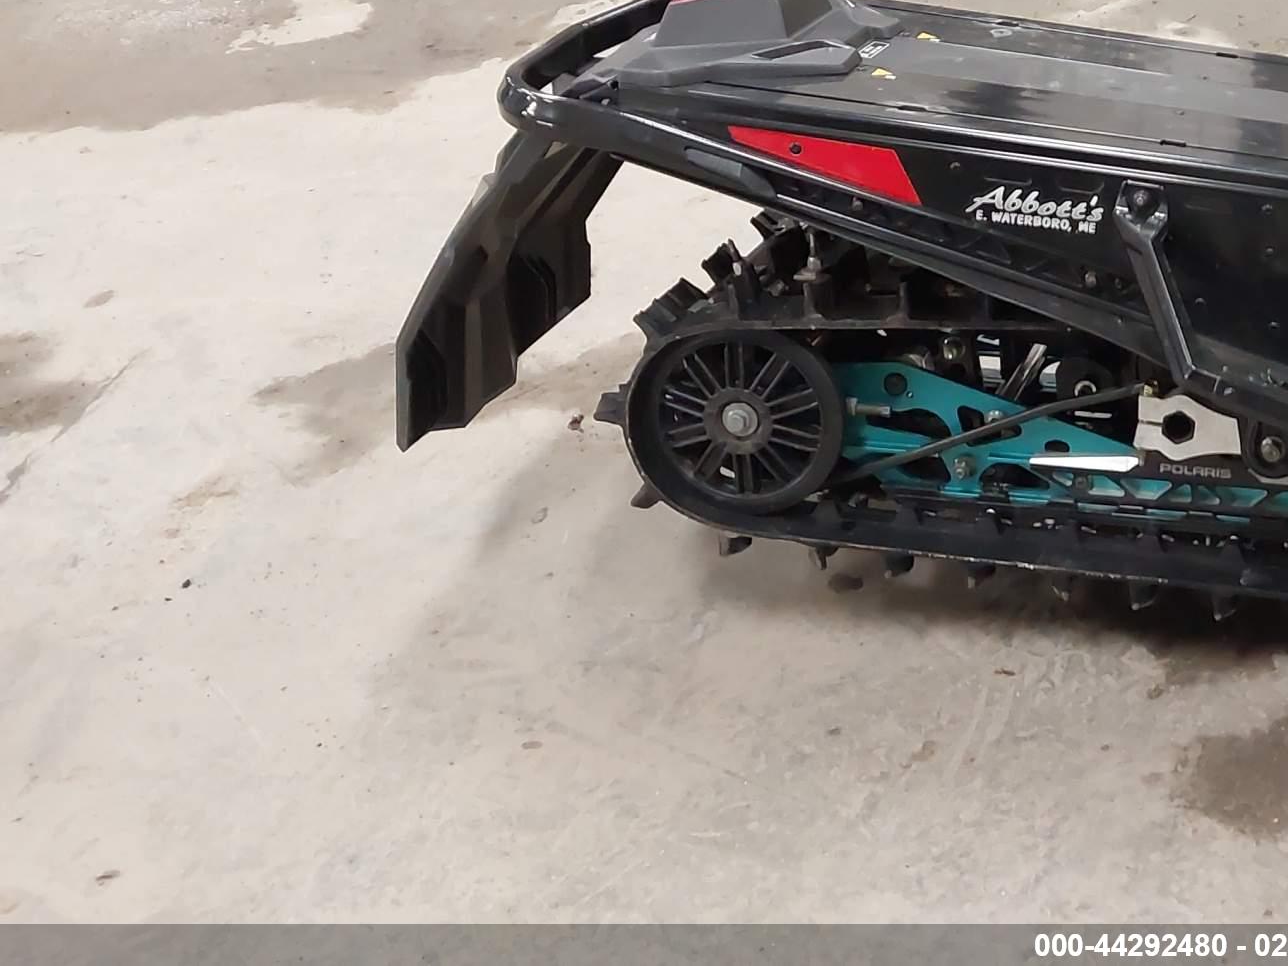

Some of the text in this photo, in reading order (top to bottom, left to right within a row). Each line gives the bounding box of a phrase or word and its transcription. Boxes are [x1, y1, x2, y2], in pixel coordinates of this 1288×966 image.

[965, 185, 1104, 222] Abbott's
[991, 211, 1072, 232] WATERBORO,
[1078, 221, 1097, 234] ME
[1160, 463, 1232, 479] POLARIS
